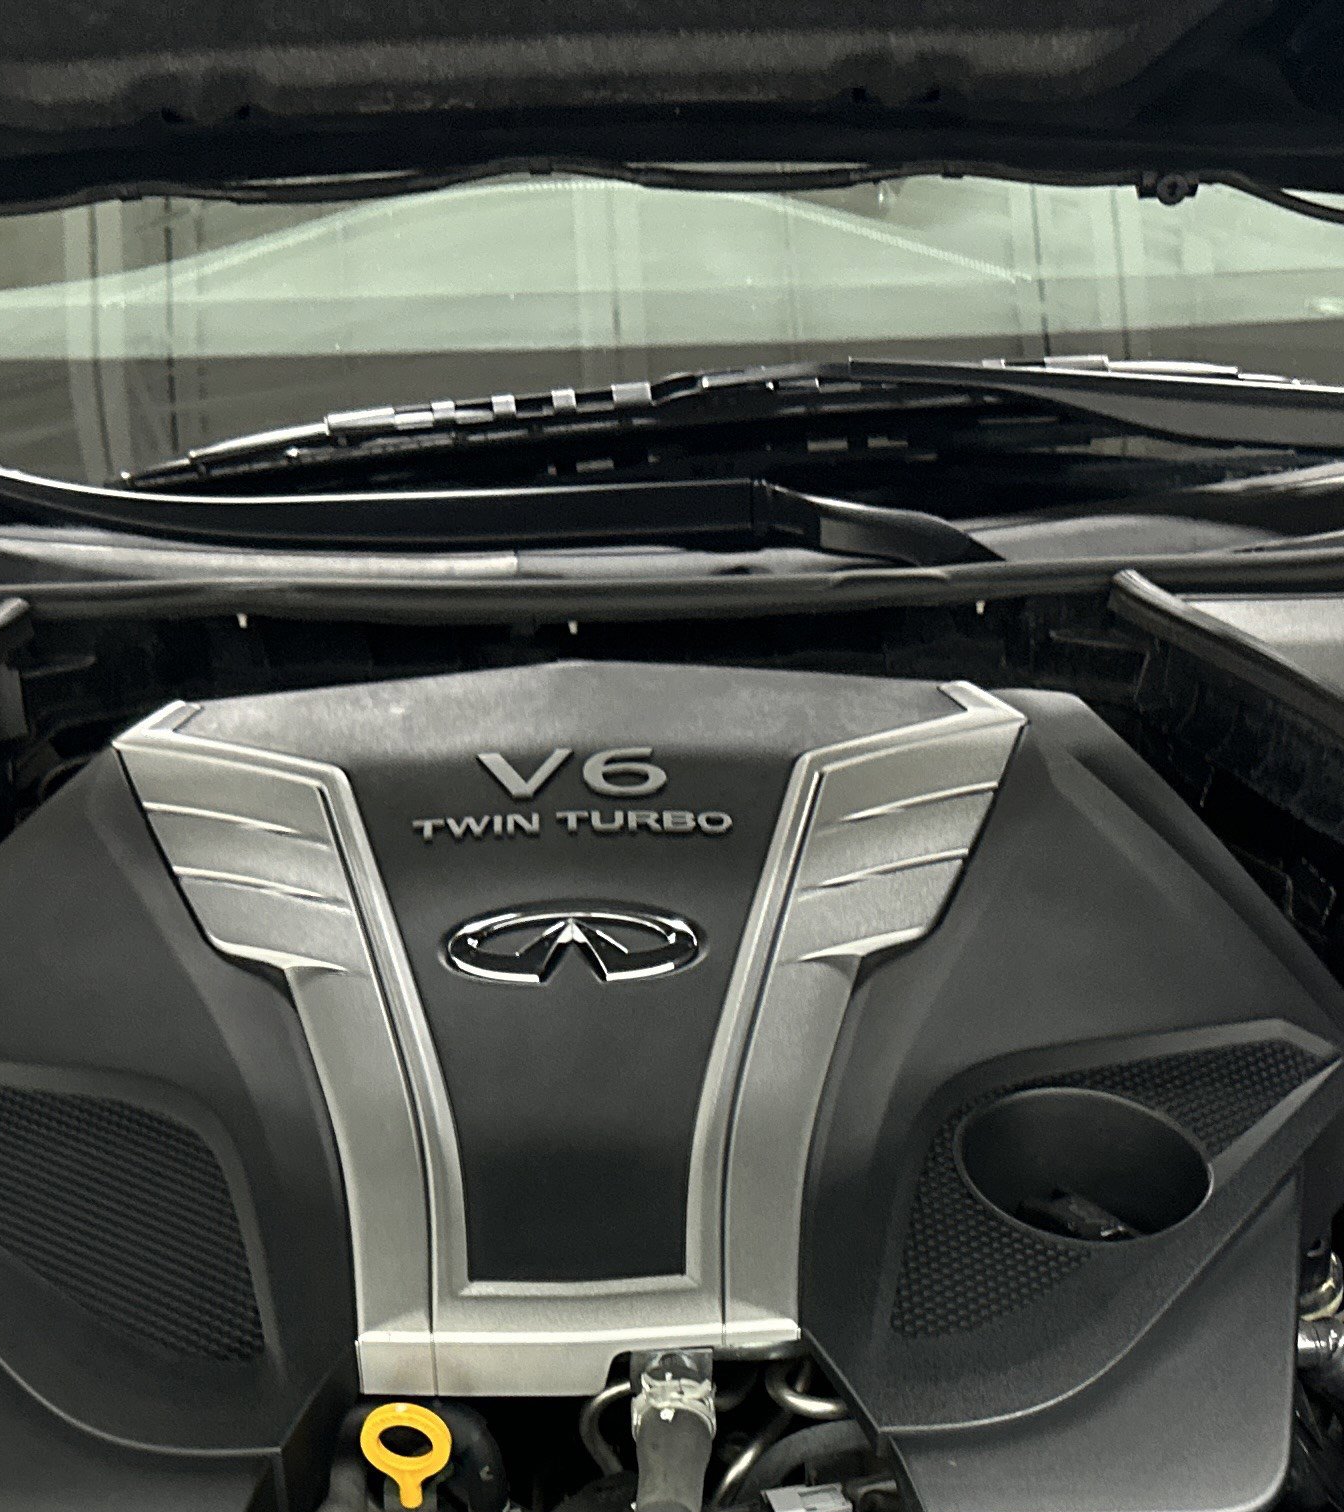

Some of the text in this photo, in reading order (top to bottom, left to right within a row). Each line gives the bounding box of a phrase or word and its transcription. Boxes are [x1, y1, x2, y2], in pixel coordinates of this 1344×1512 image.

[476, 746, 668, 800] V6
[412, 809, 734, 842] TWIN TURBO
